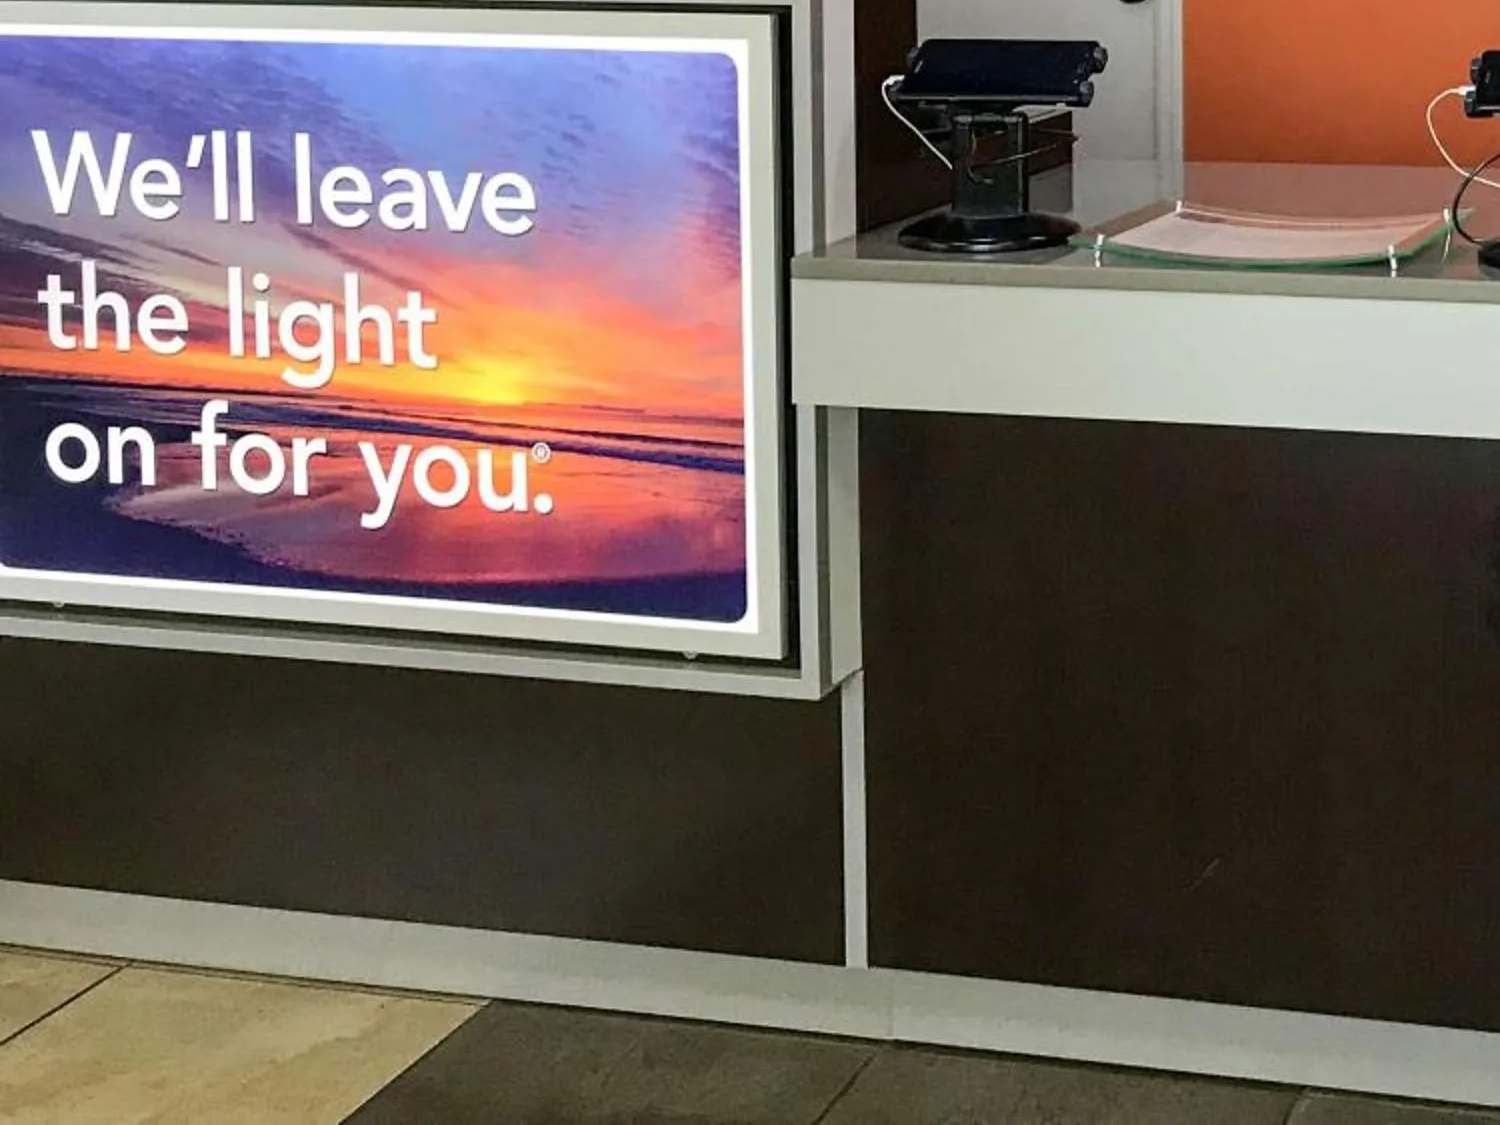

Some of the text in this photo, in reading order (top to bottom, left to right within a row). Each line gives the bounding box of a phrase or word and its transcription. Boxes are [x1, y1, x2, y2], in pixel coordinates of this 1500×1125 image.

[31, 129, 538, 236] We'll leave
[37, 260, 439, 389] the light
[45, 421, 156, 488] on
[191, 401, 328, 498] for
